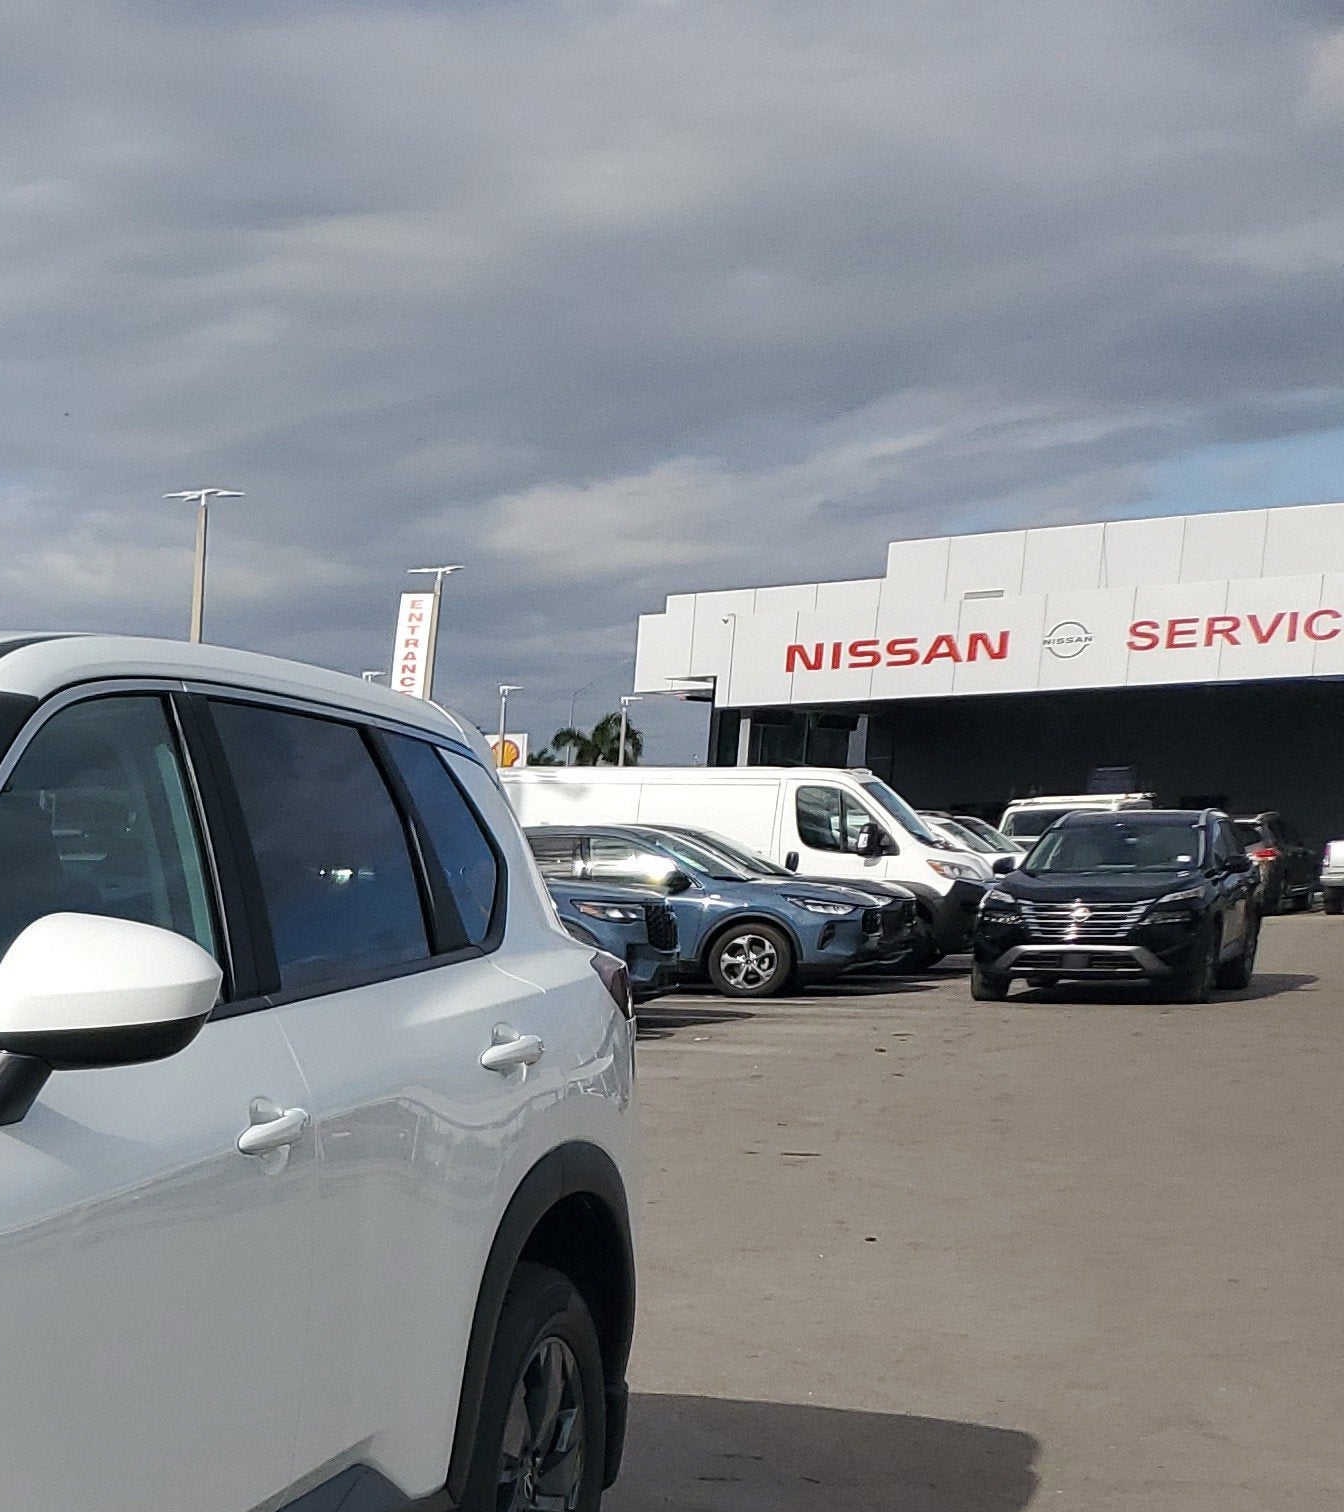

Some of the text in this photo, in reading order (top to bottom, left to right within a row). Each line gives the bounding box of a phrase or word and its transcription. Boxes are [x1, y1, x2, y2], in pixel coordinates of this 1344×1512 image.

[400, 599, 424, 695] ENTRANC
[785, 630, 1011, 673] NISSAN
[1042, 635, 1094, 646] NISSAN
